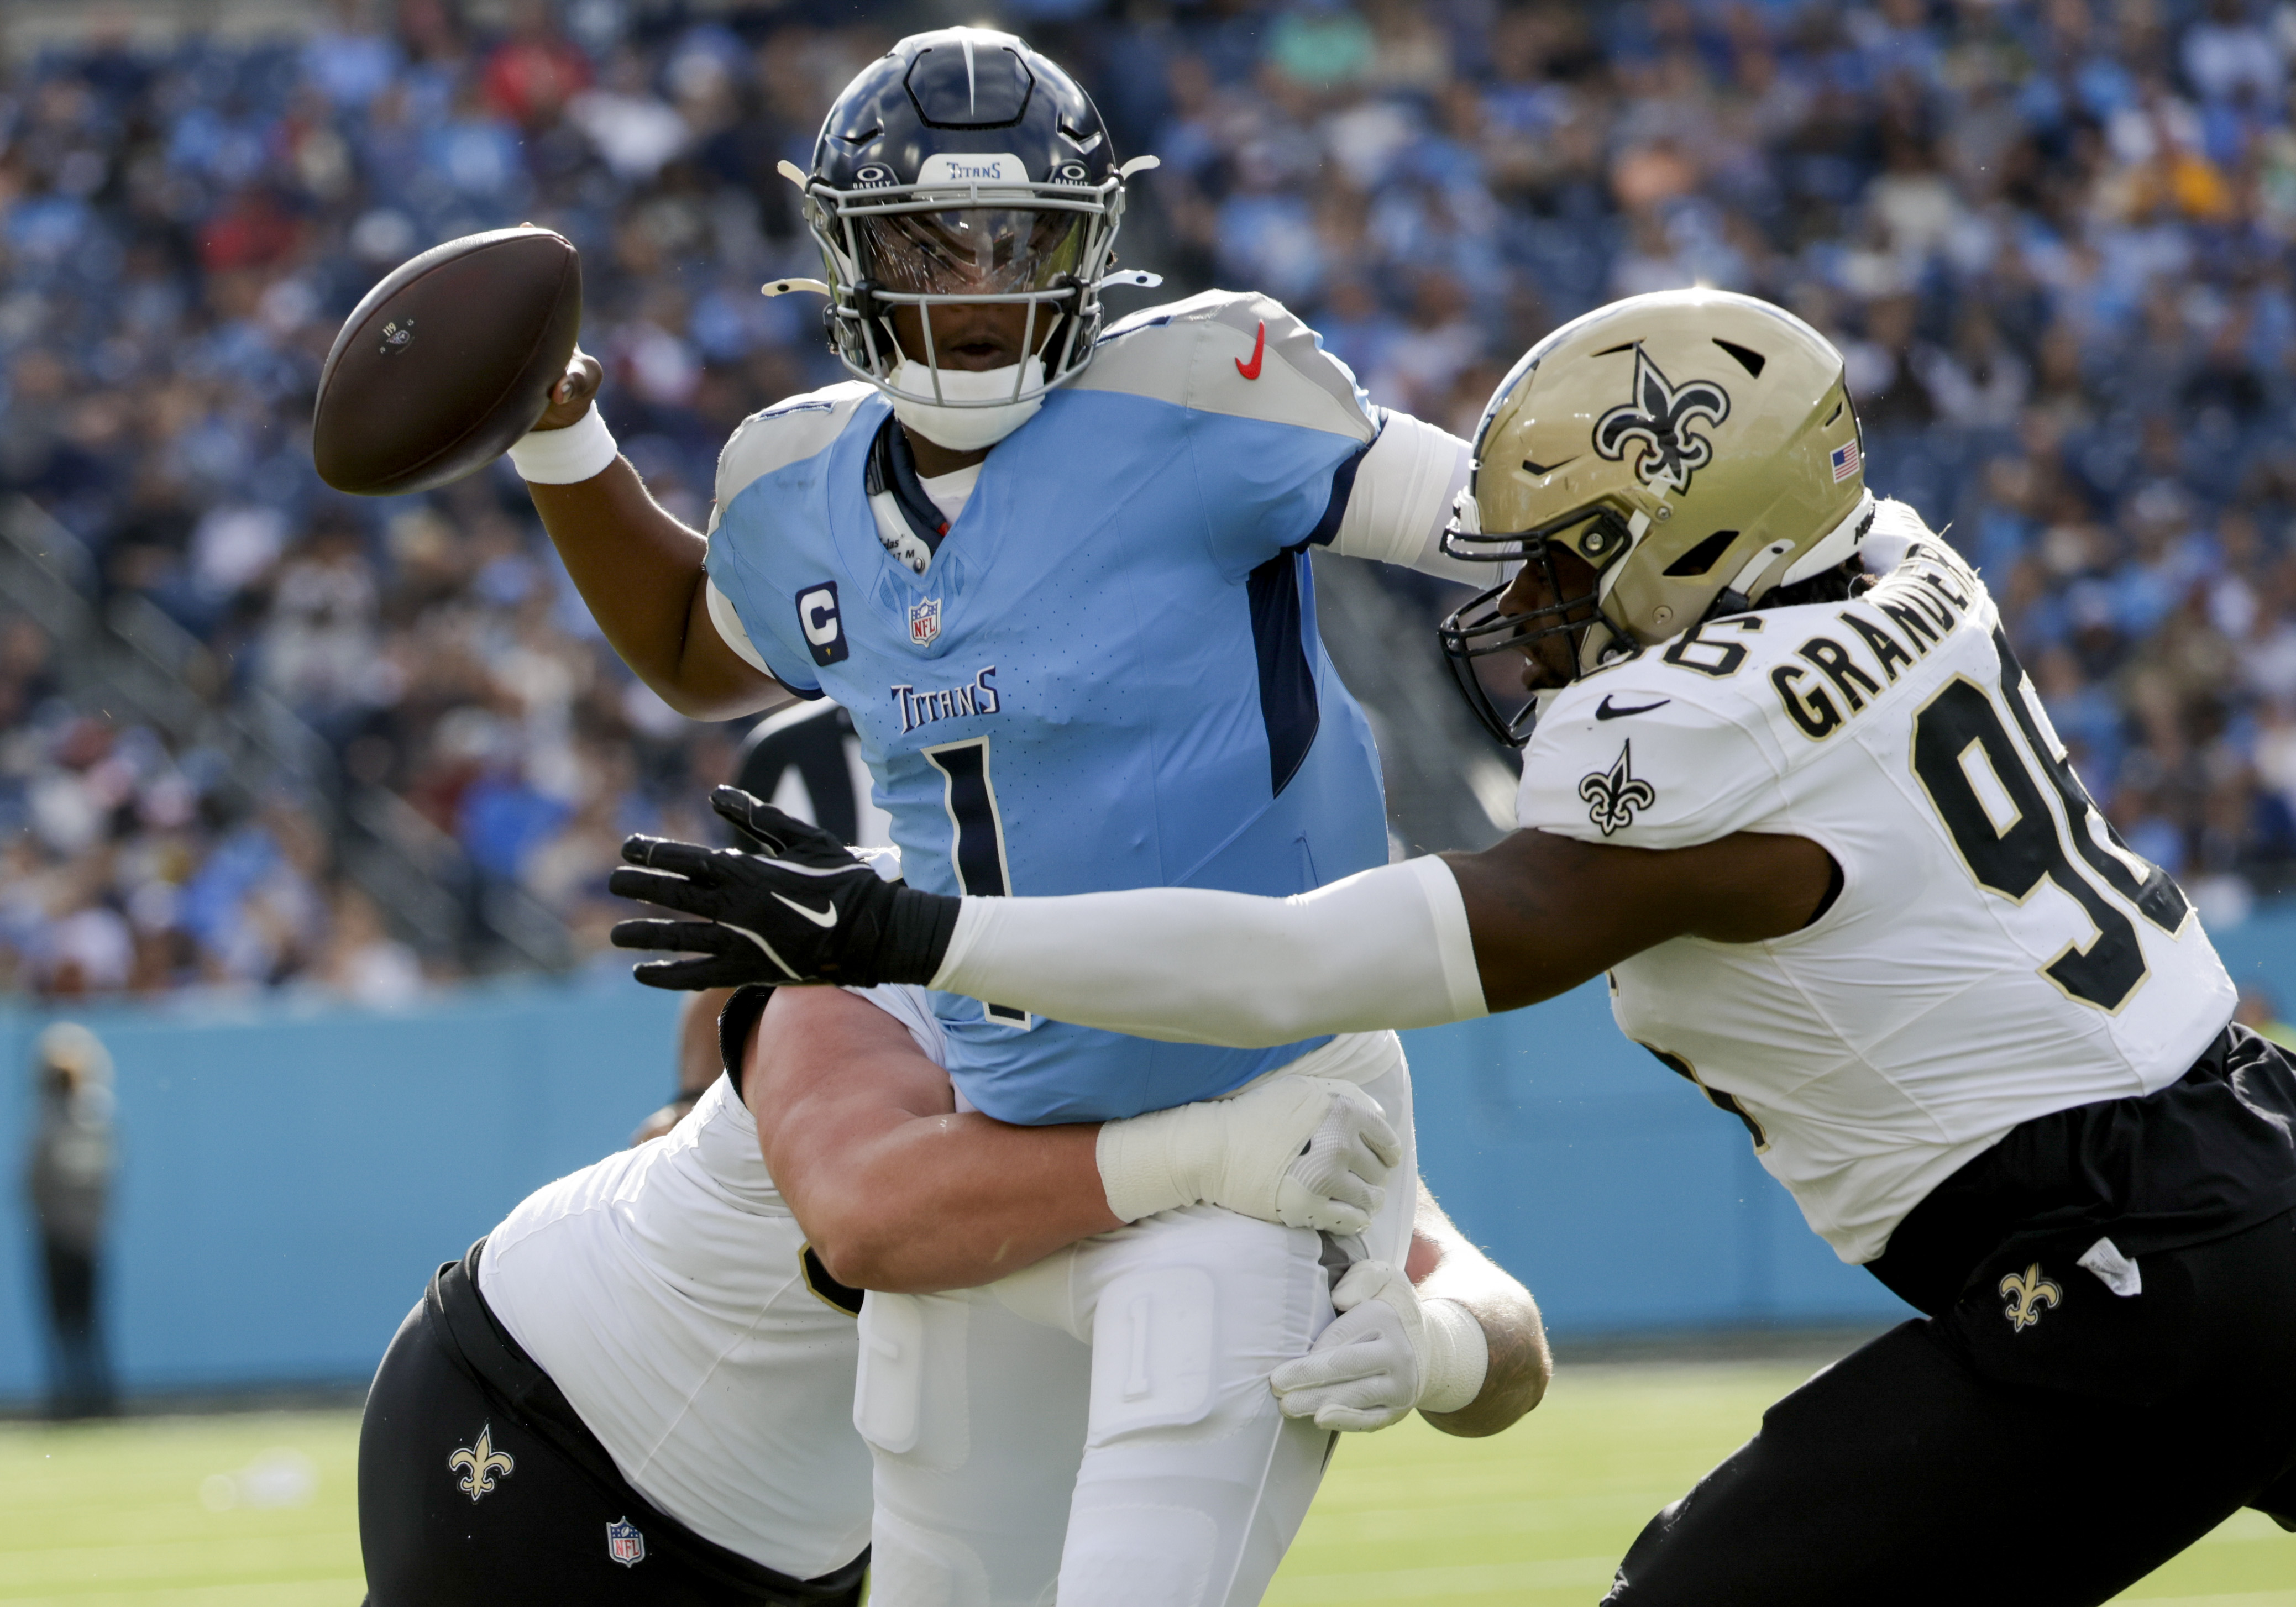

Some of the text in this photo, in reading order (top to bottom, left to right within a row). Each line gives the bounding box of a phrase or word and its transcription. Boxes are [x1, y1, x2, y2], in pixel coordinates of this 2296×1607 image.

[946, 161, 1000, 180] TITANS
[382, 322, 396, 337] 119
[905, 549, 915, 558] M
[800, 589, 838, 646] C
[914, 617, 935, 637] NFL
[890, 664, 1000, 735] TITANS
[920, 734, 1032, 1031] 1
[615, 1540, 639, 1558] NFL
